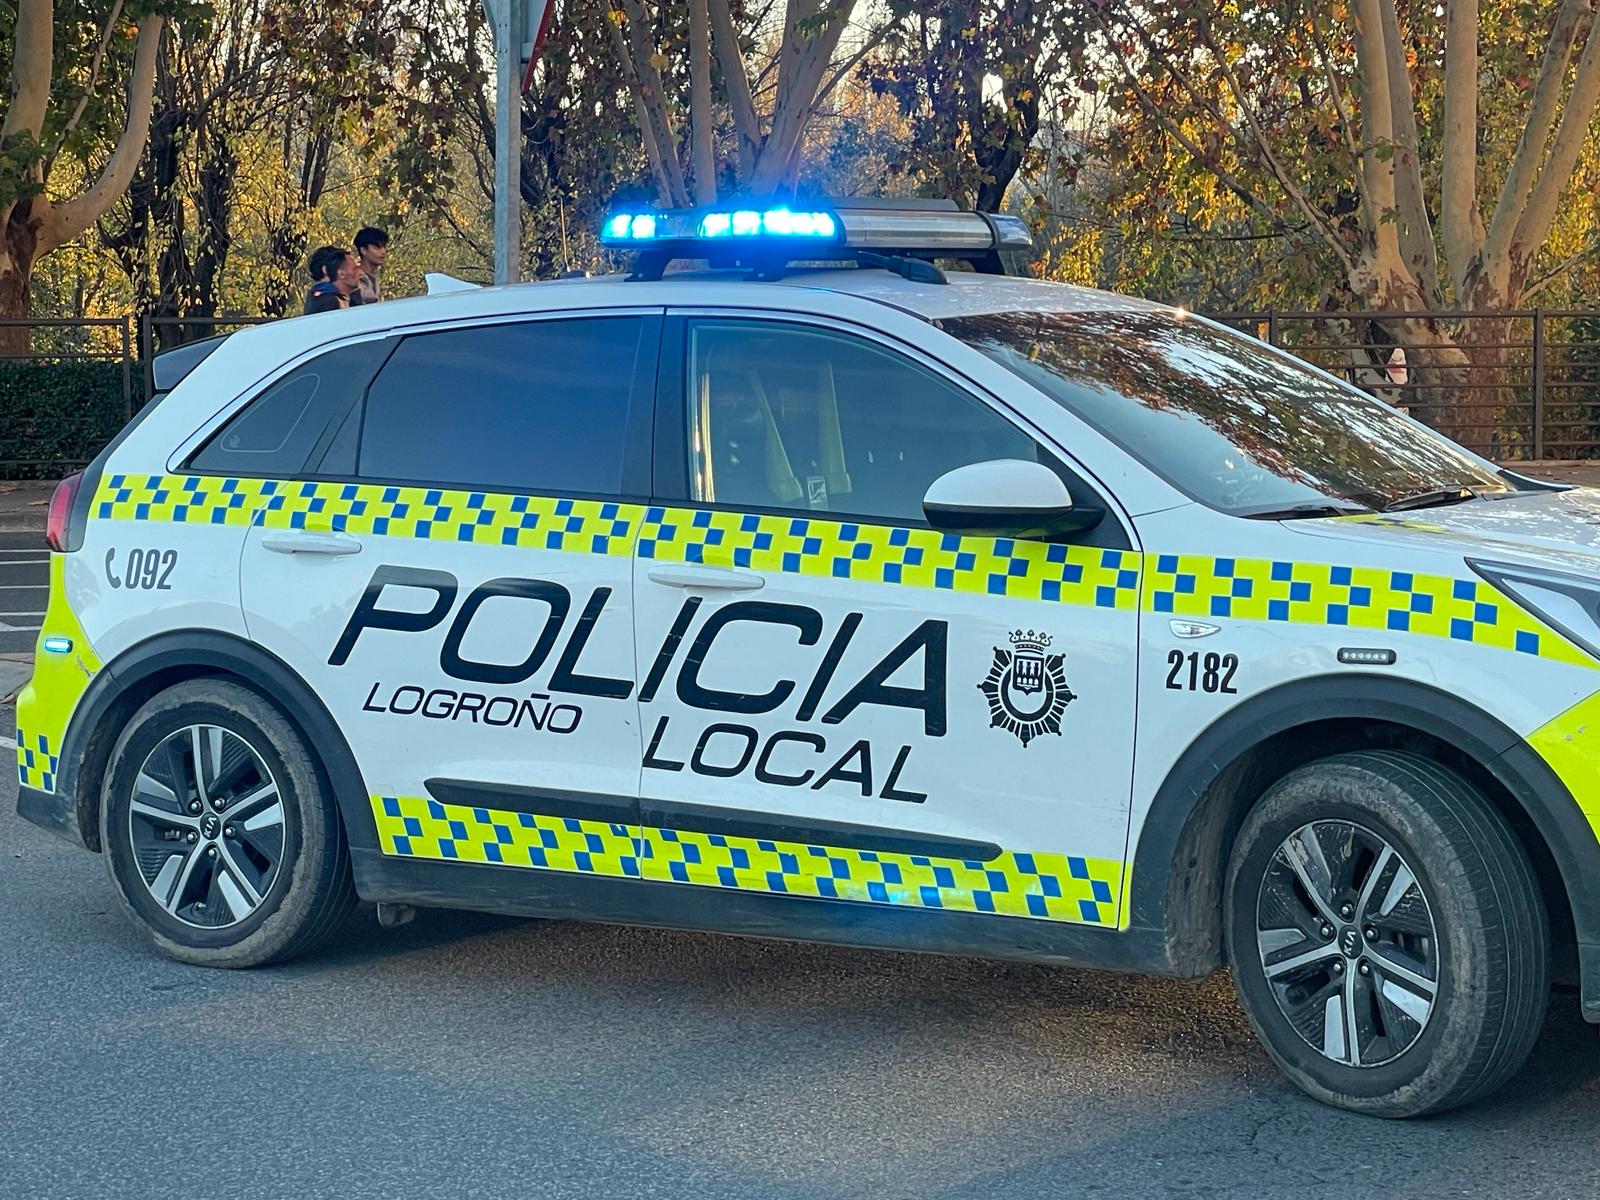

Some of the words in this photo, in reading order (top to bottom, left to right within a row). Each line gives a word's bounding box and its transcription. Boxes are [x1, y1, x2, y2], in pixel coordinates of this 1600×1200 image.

[125, 548, 178, 590] 092
[328, 564, 949, 738] POLICIA
[1166, 649, 1239, 694] 2182
[362, 682, 583, 734] LOGROÑO
[642, 716, 928, 803] LOCAL
[1343, 931, 1356, 955] KIA
